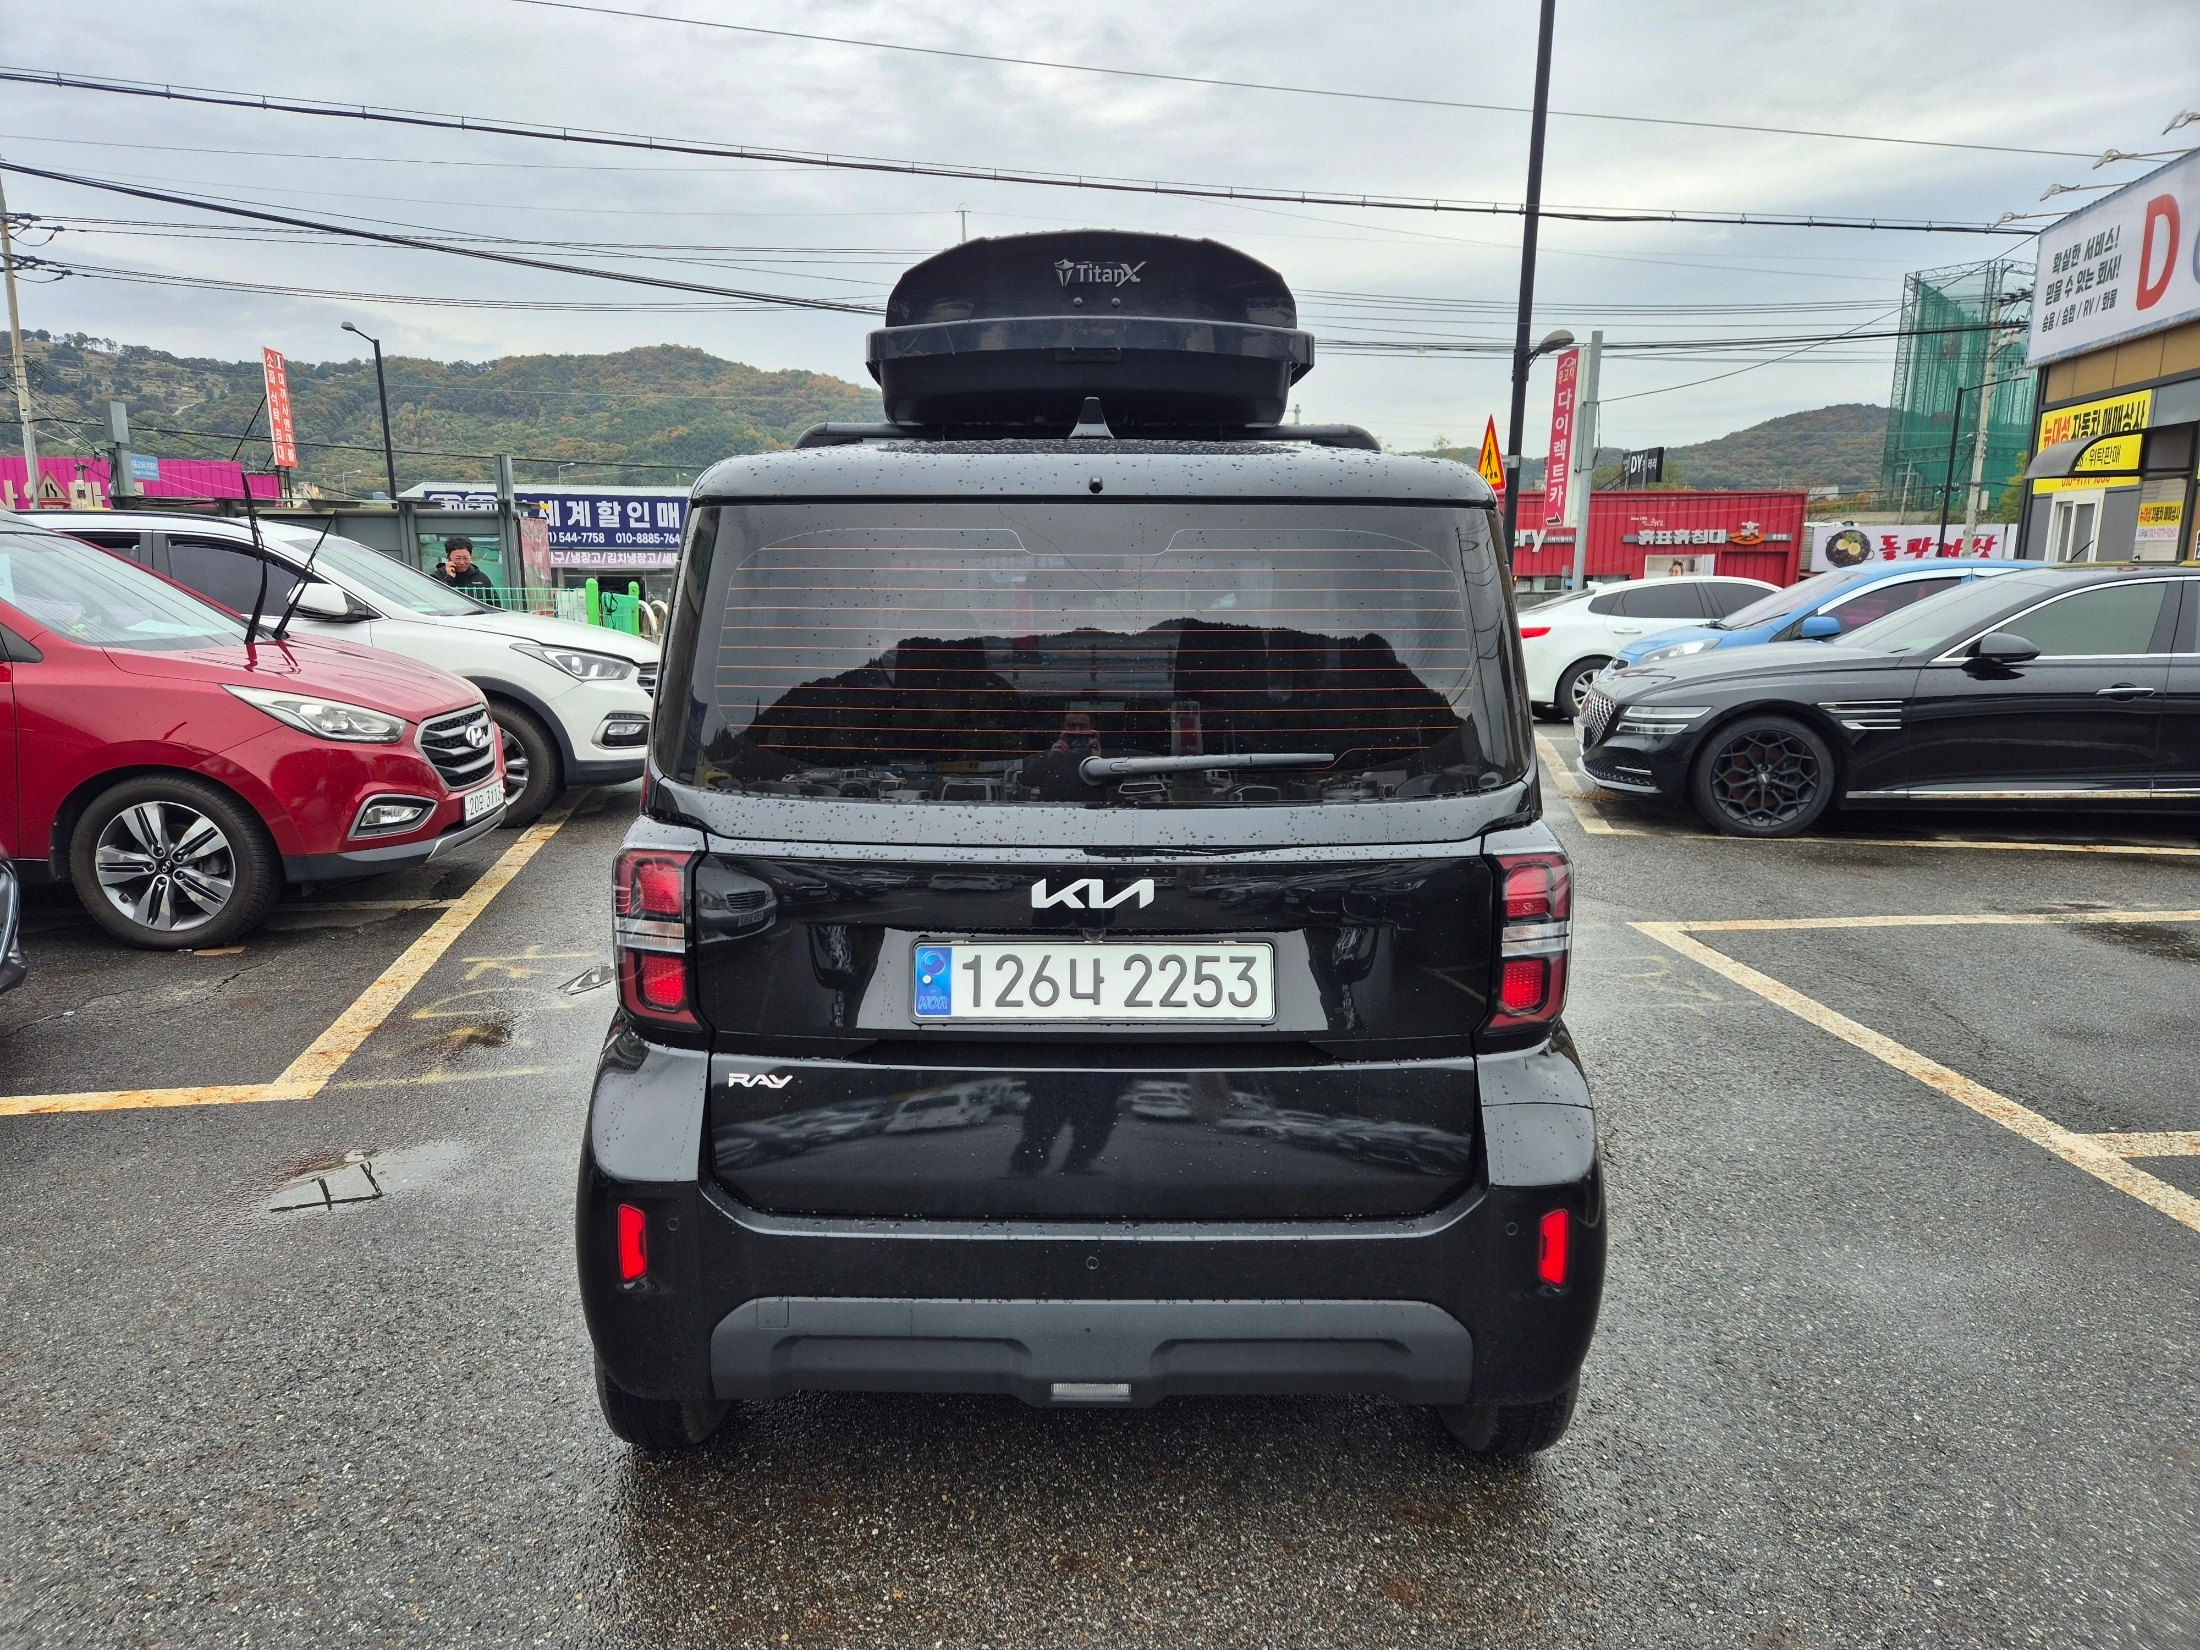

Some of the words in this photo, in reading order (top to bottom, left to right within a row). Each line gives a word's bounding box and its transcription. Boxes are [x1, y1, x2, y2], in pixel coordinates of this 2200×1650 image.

[2052, 243, 2081, 275] 확실한
[2083, 224, 2121, 262] 서비스!
[1076, 260, 1147, 287] TitanX
[2045, 279, 2063, 306] 믿을
[2065, 275, 2074, 298] 수
[2075, 267, 2095, 295] 있는
[2096, 254, 2122, 286] 회사!
[2042, 312, 2056, 333] 승용
[2062, 303, 2077, 326] 승합
[2083, 297, 2095, 318] RV
[2101, 288, 2118, 311] 화물
[1557, 366, 1575, 385] 중고차
[1549, 387, 1573, 507] 다이렉트카
[521, 500, 688, 528] 세계할인매
[559, 531, 605, 544] 544-7758
[616, 532, 681, 545] 010-8885-764
[1031, 878, 1155, 908] KIA
[962, 953, 1105, 1008] 126나
[1123, 953, 1258, 1008] 2253
[917, 995, 949, 1010] KOR
[728, 1072, 794, 1089] RAY
